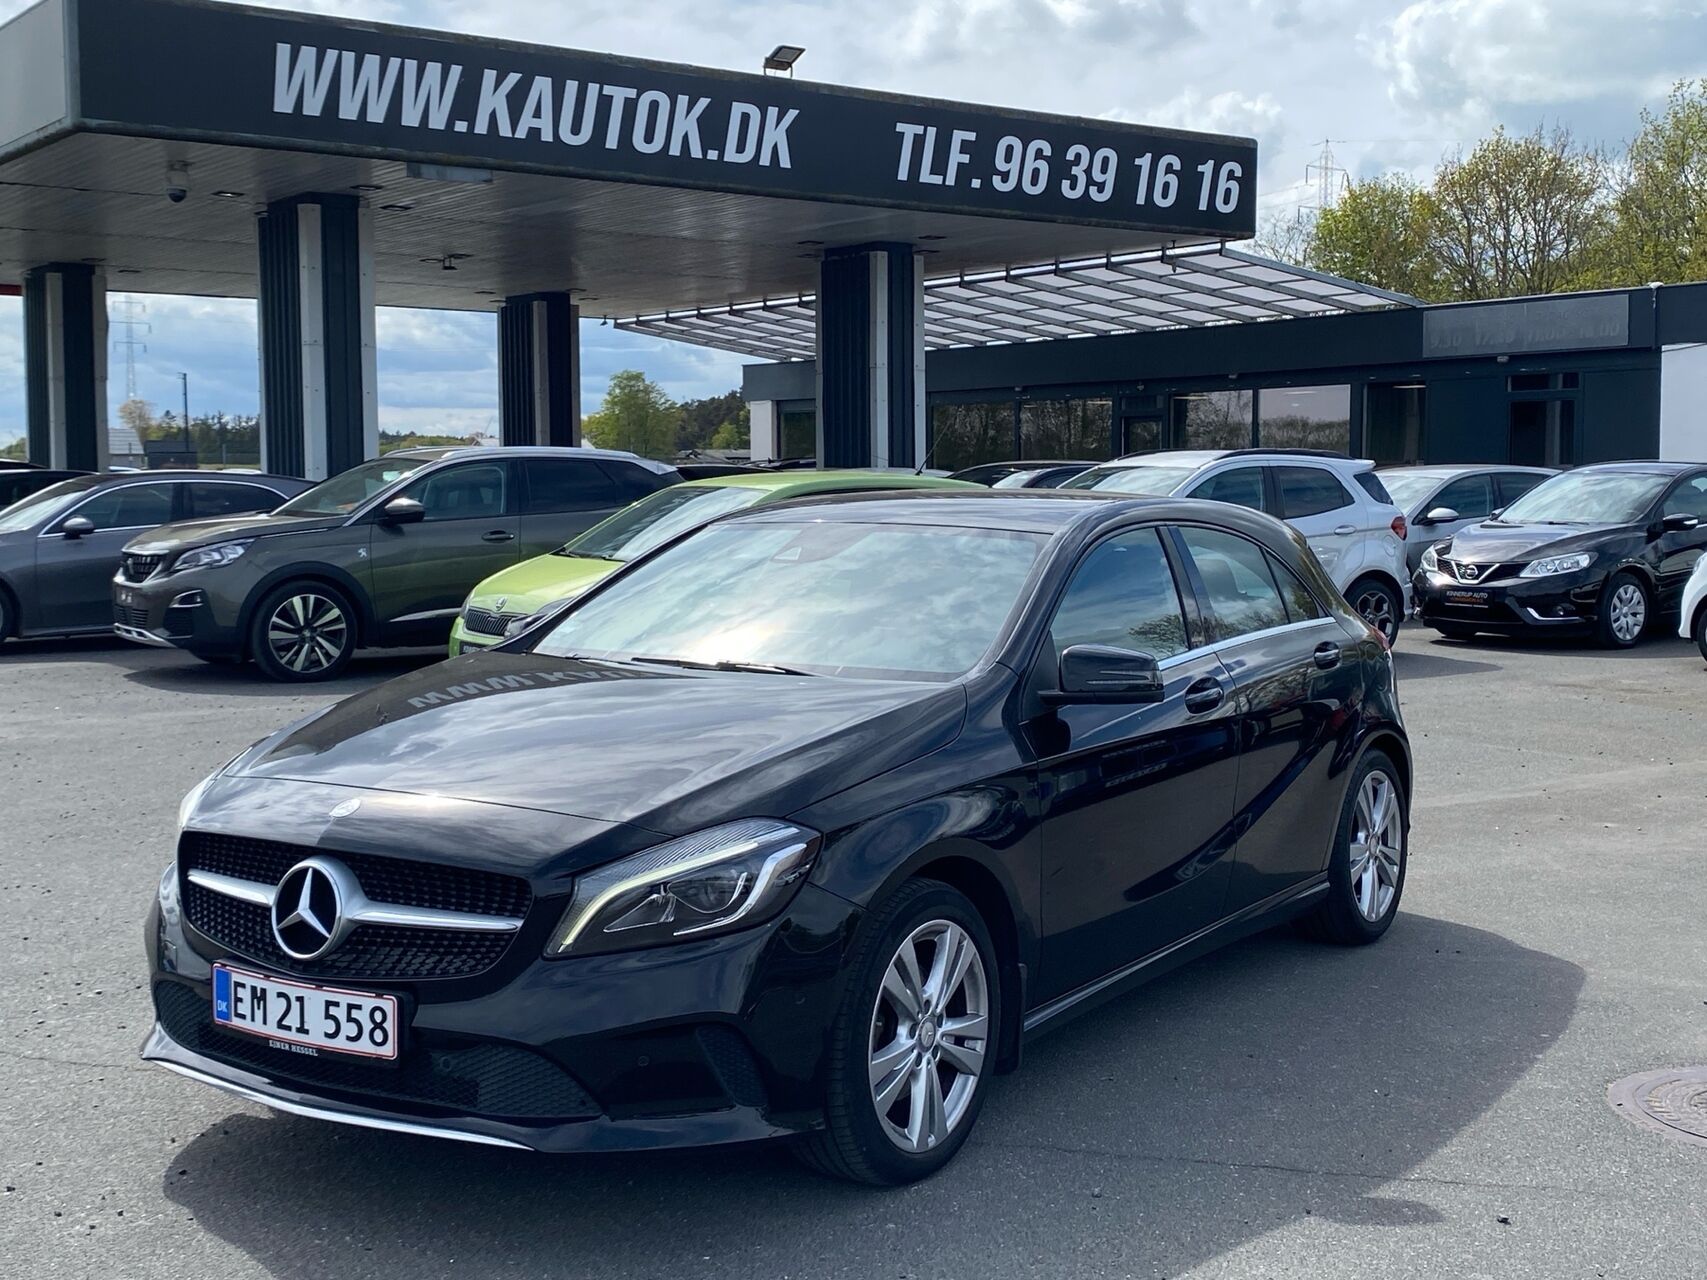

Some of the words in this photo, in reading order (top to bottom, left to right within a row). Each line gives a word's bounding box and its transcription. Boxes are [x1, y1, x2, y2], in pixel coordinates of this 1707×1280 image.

[274, 42, 799, 169] WWW.KAUTOK.DK
[895, 122, 981, 188] TLF.
[992, 135, 1052, 195] 96
[1061, 144, 1118, 202] 39
[1134, 152, 1182, 208] 16
[1197, 159, 1243, 214] 16
[217, 1001, 228, 1013] DK
[233, 981, 267, 1026] EM
[276, 992, 310, 1035] 21
[324, 1000, 389, 1047] 558
